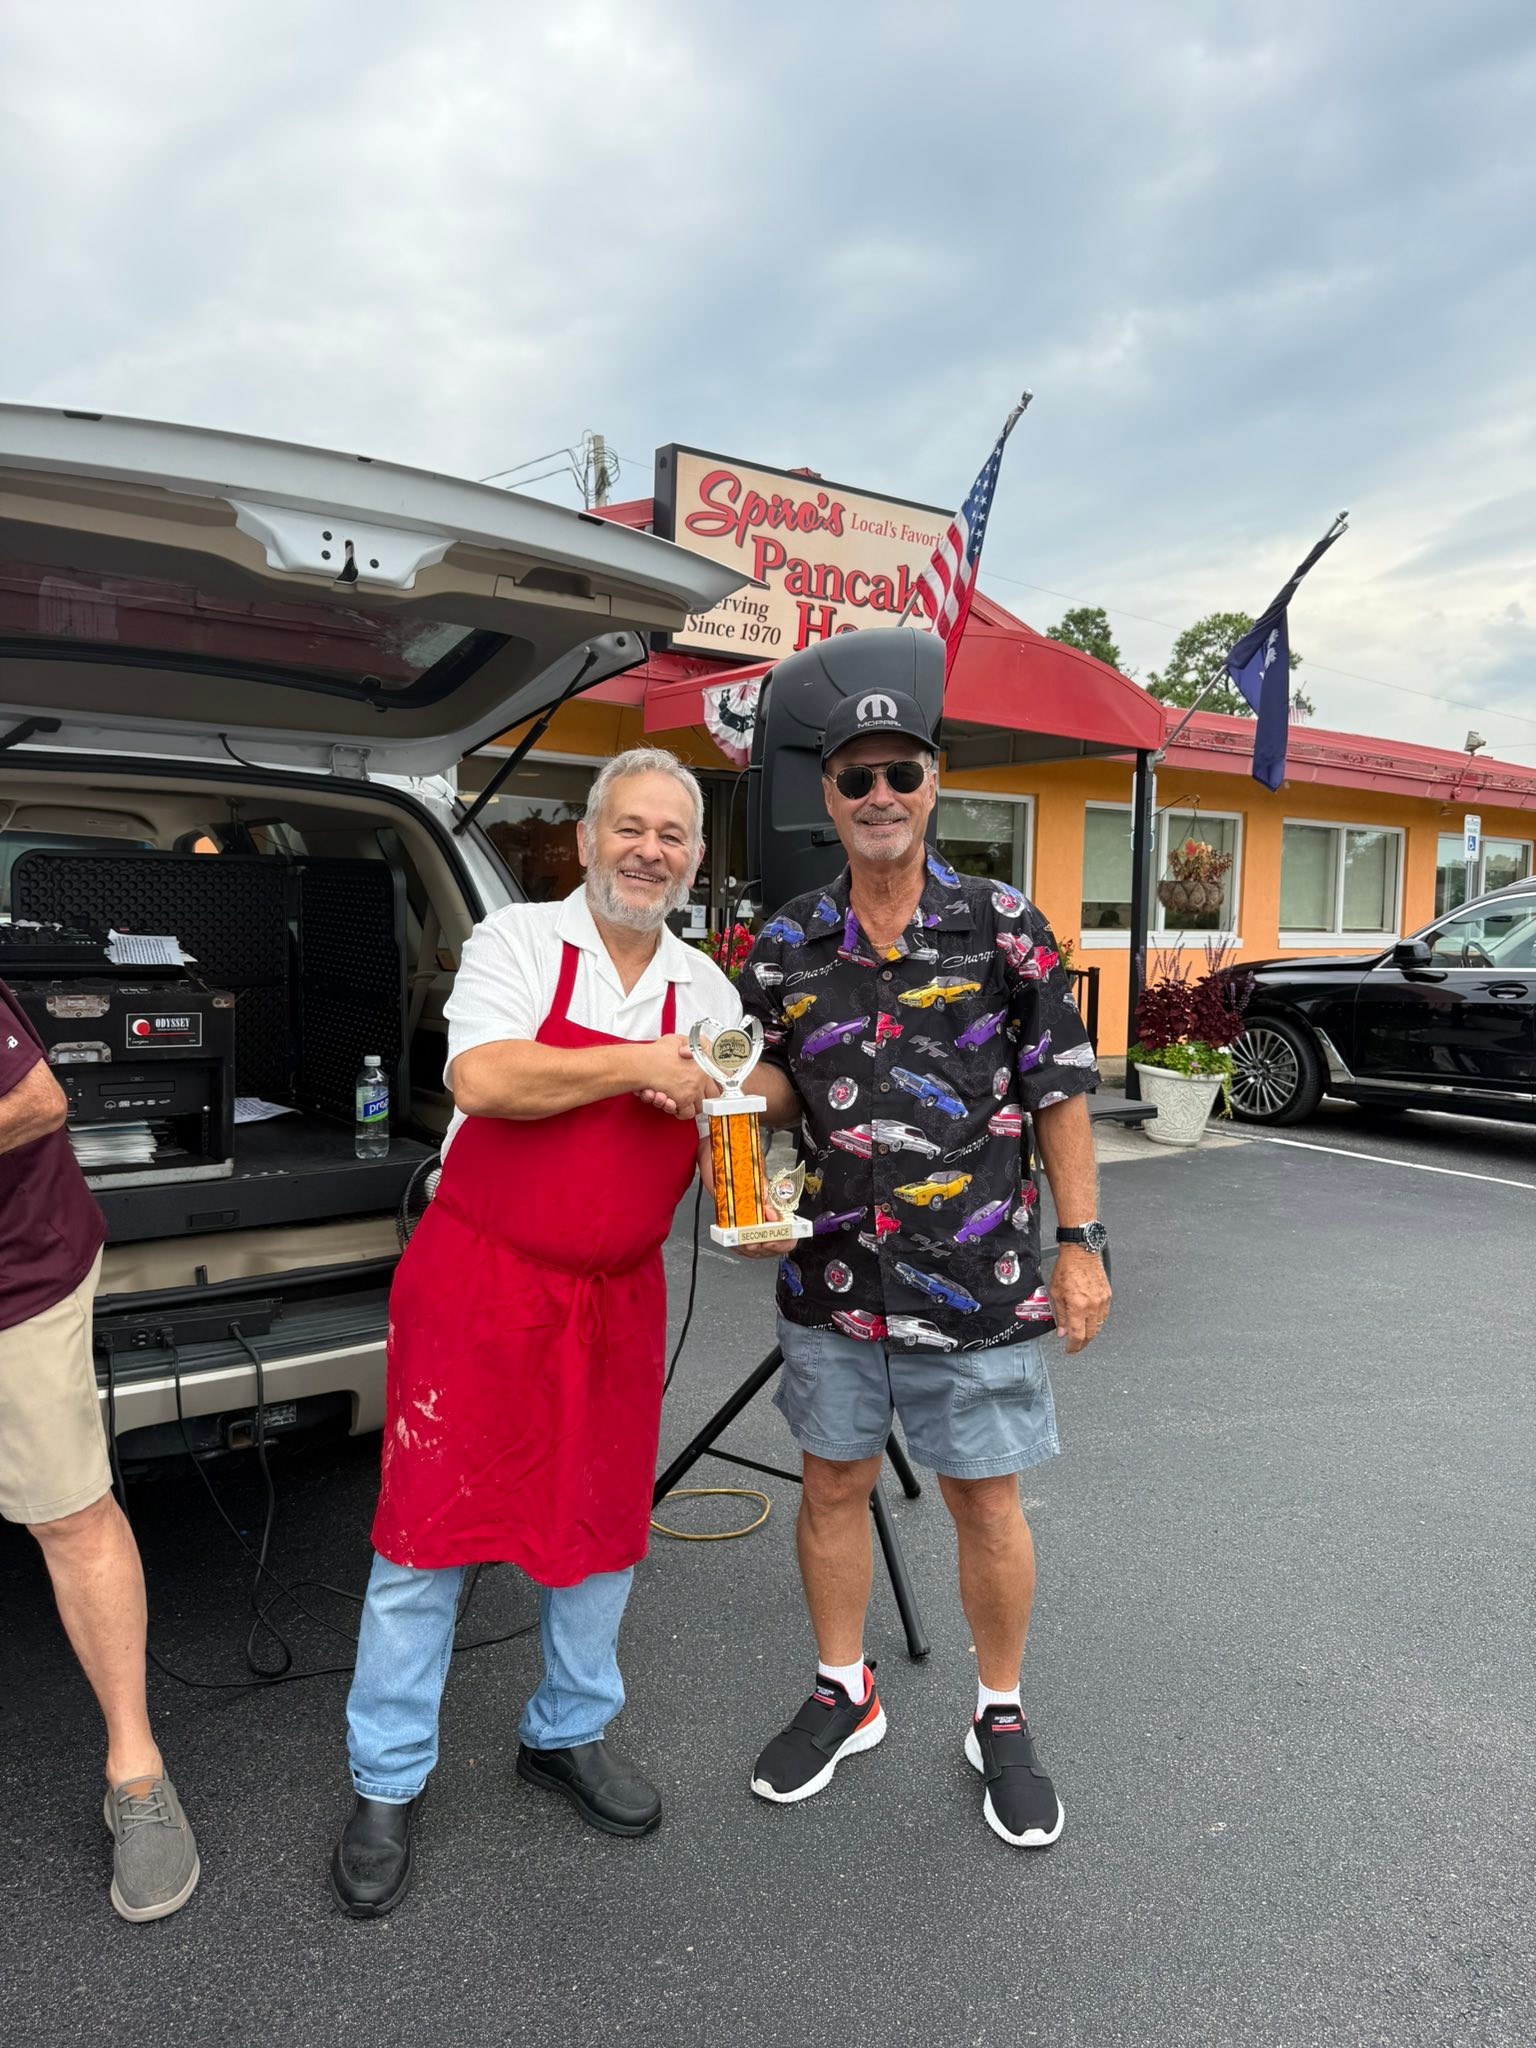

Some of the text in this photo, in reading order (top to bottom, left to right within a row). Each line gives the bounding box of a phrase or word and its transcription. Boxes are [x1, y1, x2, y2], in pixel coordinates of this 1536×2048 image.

[685, 470, 846, 547] Spiro's
[850, 512, 944, 548] Local's Favori
[750, 535, 924, 618] Pancak
[687, 613, 735, 639] Since
[740, 623, 782, 646] 1970
[155, 1017, 190, 1028] ODYSSEY
[741, 1227, 790, 1241] SECOND PLACE
